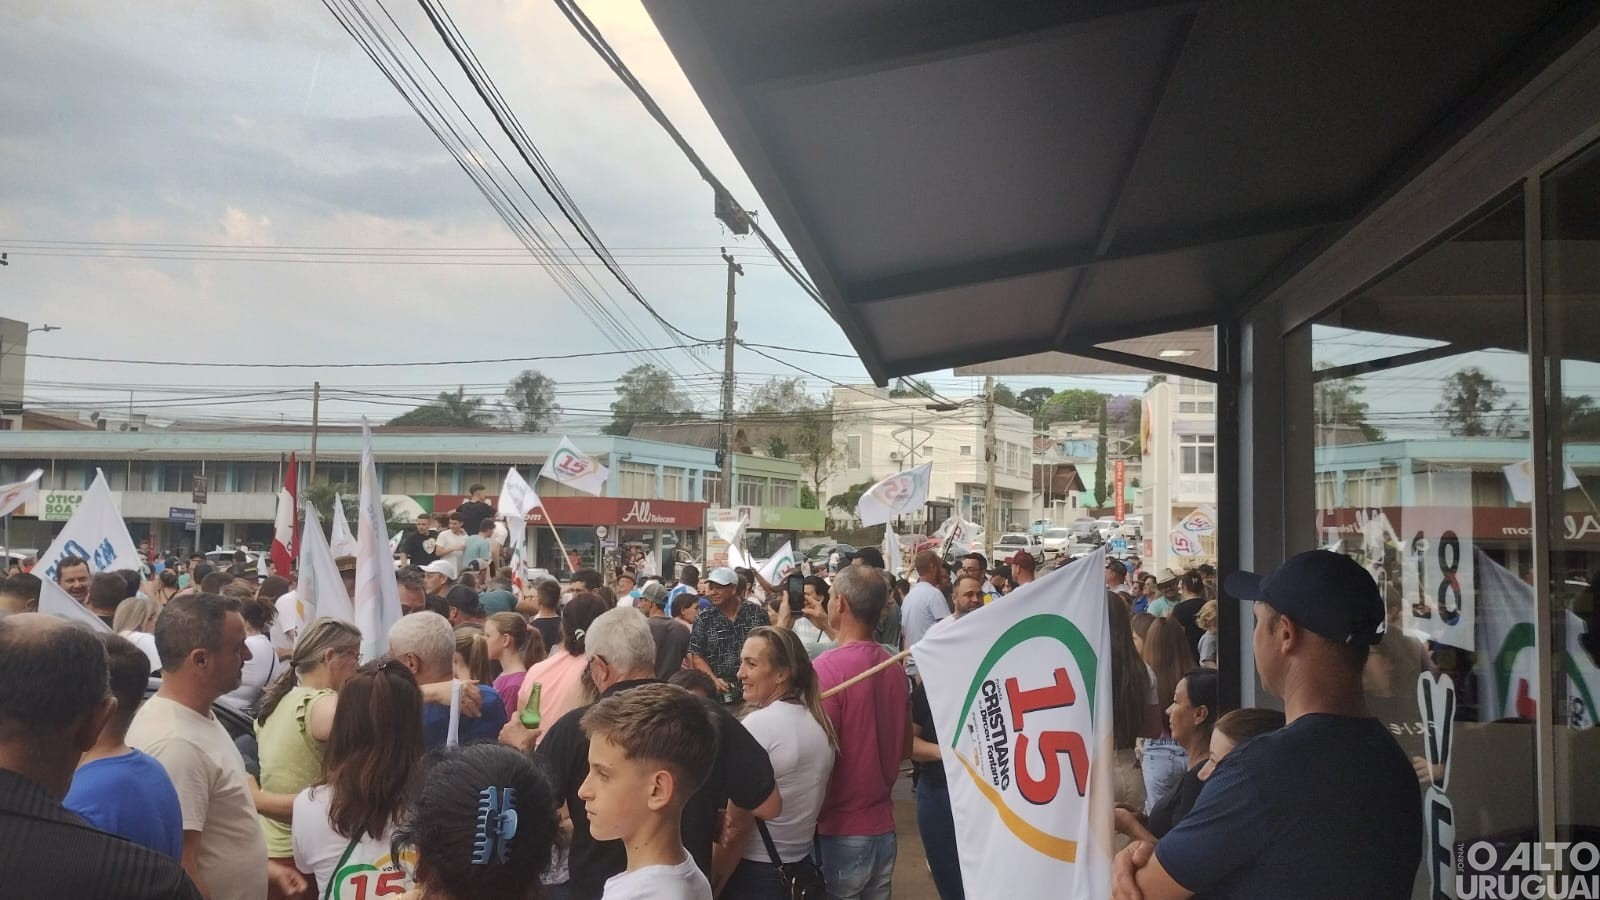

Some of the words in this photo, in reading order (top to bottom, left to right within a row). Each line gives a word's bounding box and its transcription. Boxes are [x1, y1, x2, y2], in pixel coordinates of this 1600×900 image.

[559, 455, 586, 474] 15
[45, 504, 72, 513] BOA
[622, 500, 651, 523] All
[651, 514, 676, 524] Telecom
[1411, 530, 1462, 626] 18
[980, 709, 991, 741] Dirceu
[987, 745, 1000, 786] Fontana
[1005, 667, 1089, 805] 15
[350, 871, 407, 900] 15
